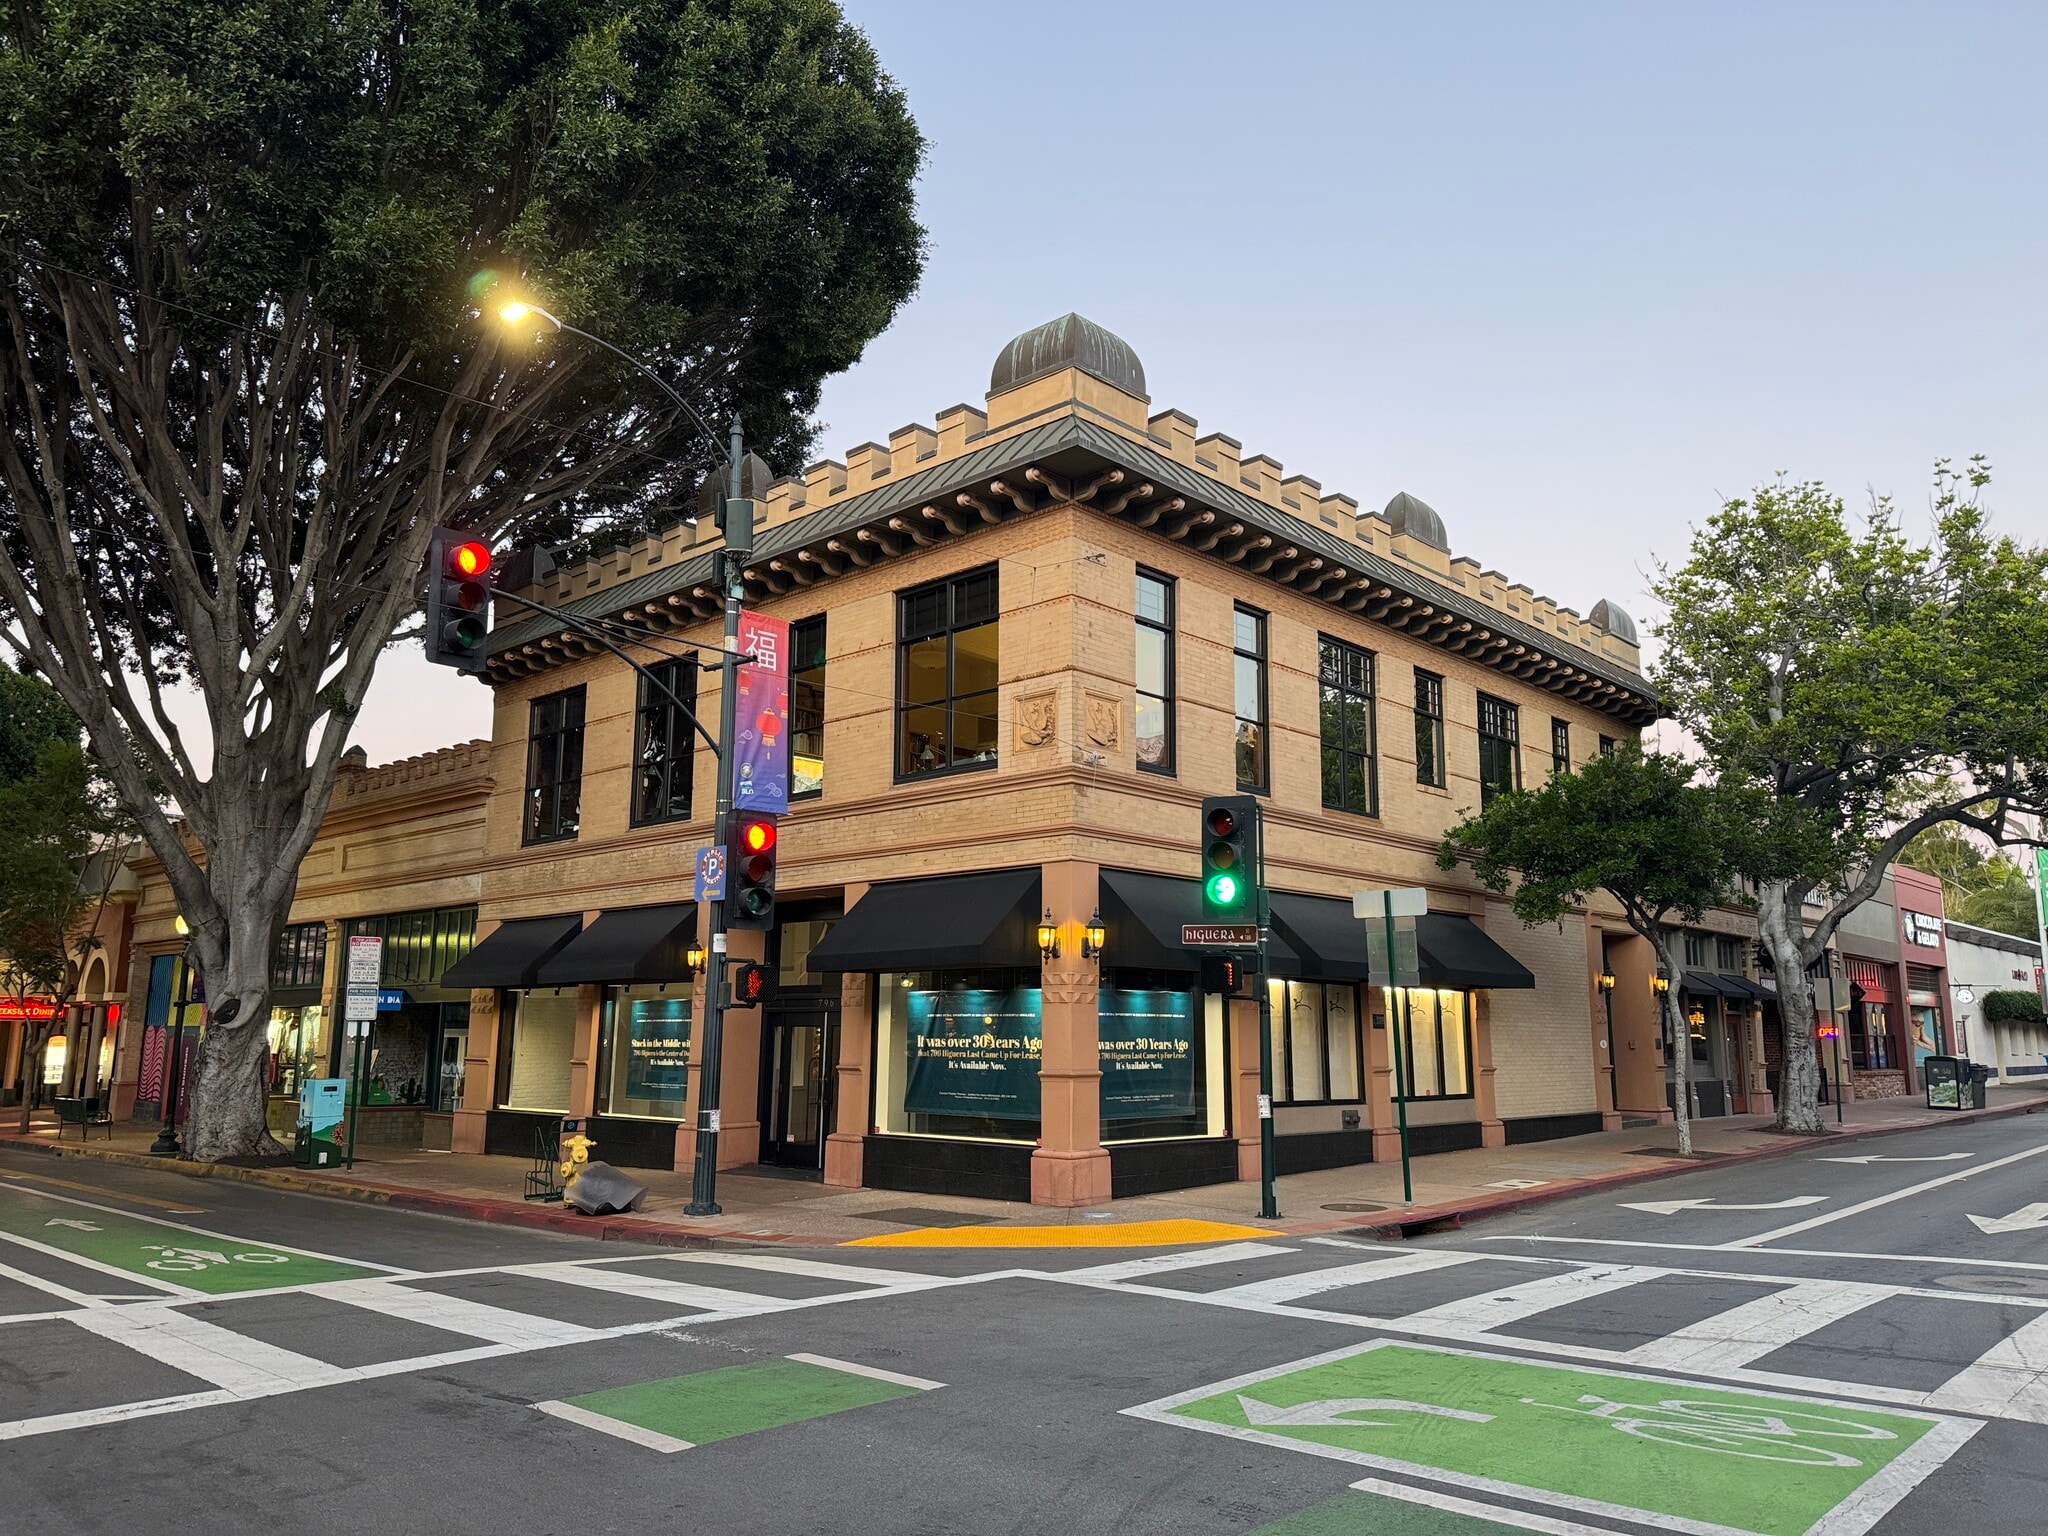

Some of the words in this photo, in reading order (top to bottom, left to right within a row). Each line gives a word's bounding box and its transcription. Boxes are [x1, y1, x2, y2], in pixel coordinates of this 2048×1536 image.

[746, 627, 778, 671] 福
[704, 849, 723, 862] PUBLIC
[708, 858, 718, 876] P
[702, 869, 722, 885] PARKING
[1915, 913, 1942, 931] CHOCOLATE
[1922, 931, 1939, 947] GELATO
[818, 999, 834, 1007] 796
[632, 1039, 646, 1048] Stuck
[663, 1039, 681, 1047] Middle
[917, 1035, 924, 1048] It
[926, 1039, 946, 1048] was
[948, 1039, 971, 1048] over
[972, 1035, 987, 1048] 30
[989, 1035, 1020, 1048] Years
[1022, 1036, 1042, 1053] Ago
[1098, 1041, 1114, 1050] was
[1116, 1041, 1135, 1050] over
[1136, 1038, 1147, 1050] 30
[1149, 1038, 1172, 1050] Years
[1173, 1038, 1188, 1053] Ago
[942, 1050, 966, 1059] Higuera
[1000, 1050, 1008, 1060] Up
[1111, 1052, 1131, 1060] Higuera
[948, 1061, 958, 1069] It's
[960, 1061, 989, 1070] Available
[990, 1062, 1006, 1070] Now.
[1116, 1062, 1124, 1070] It's
[1126, 1061, 1150, 1070] Available
